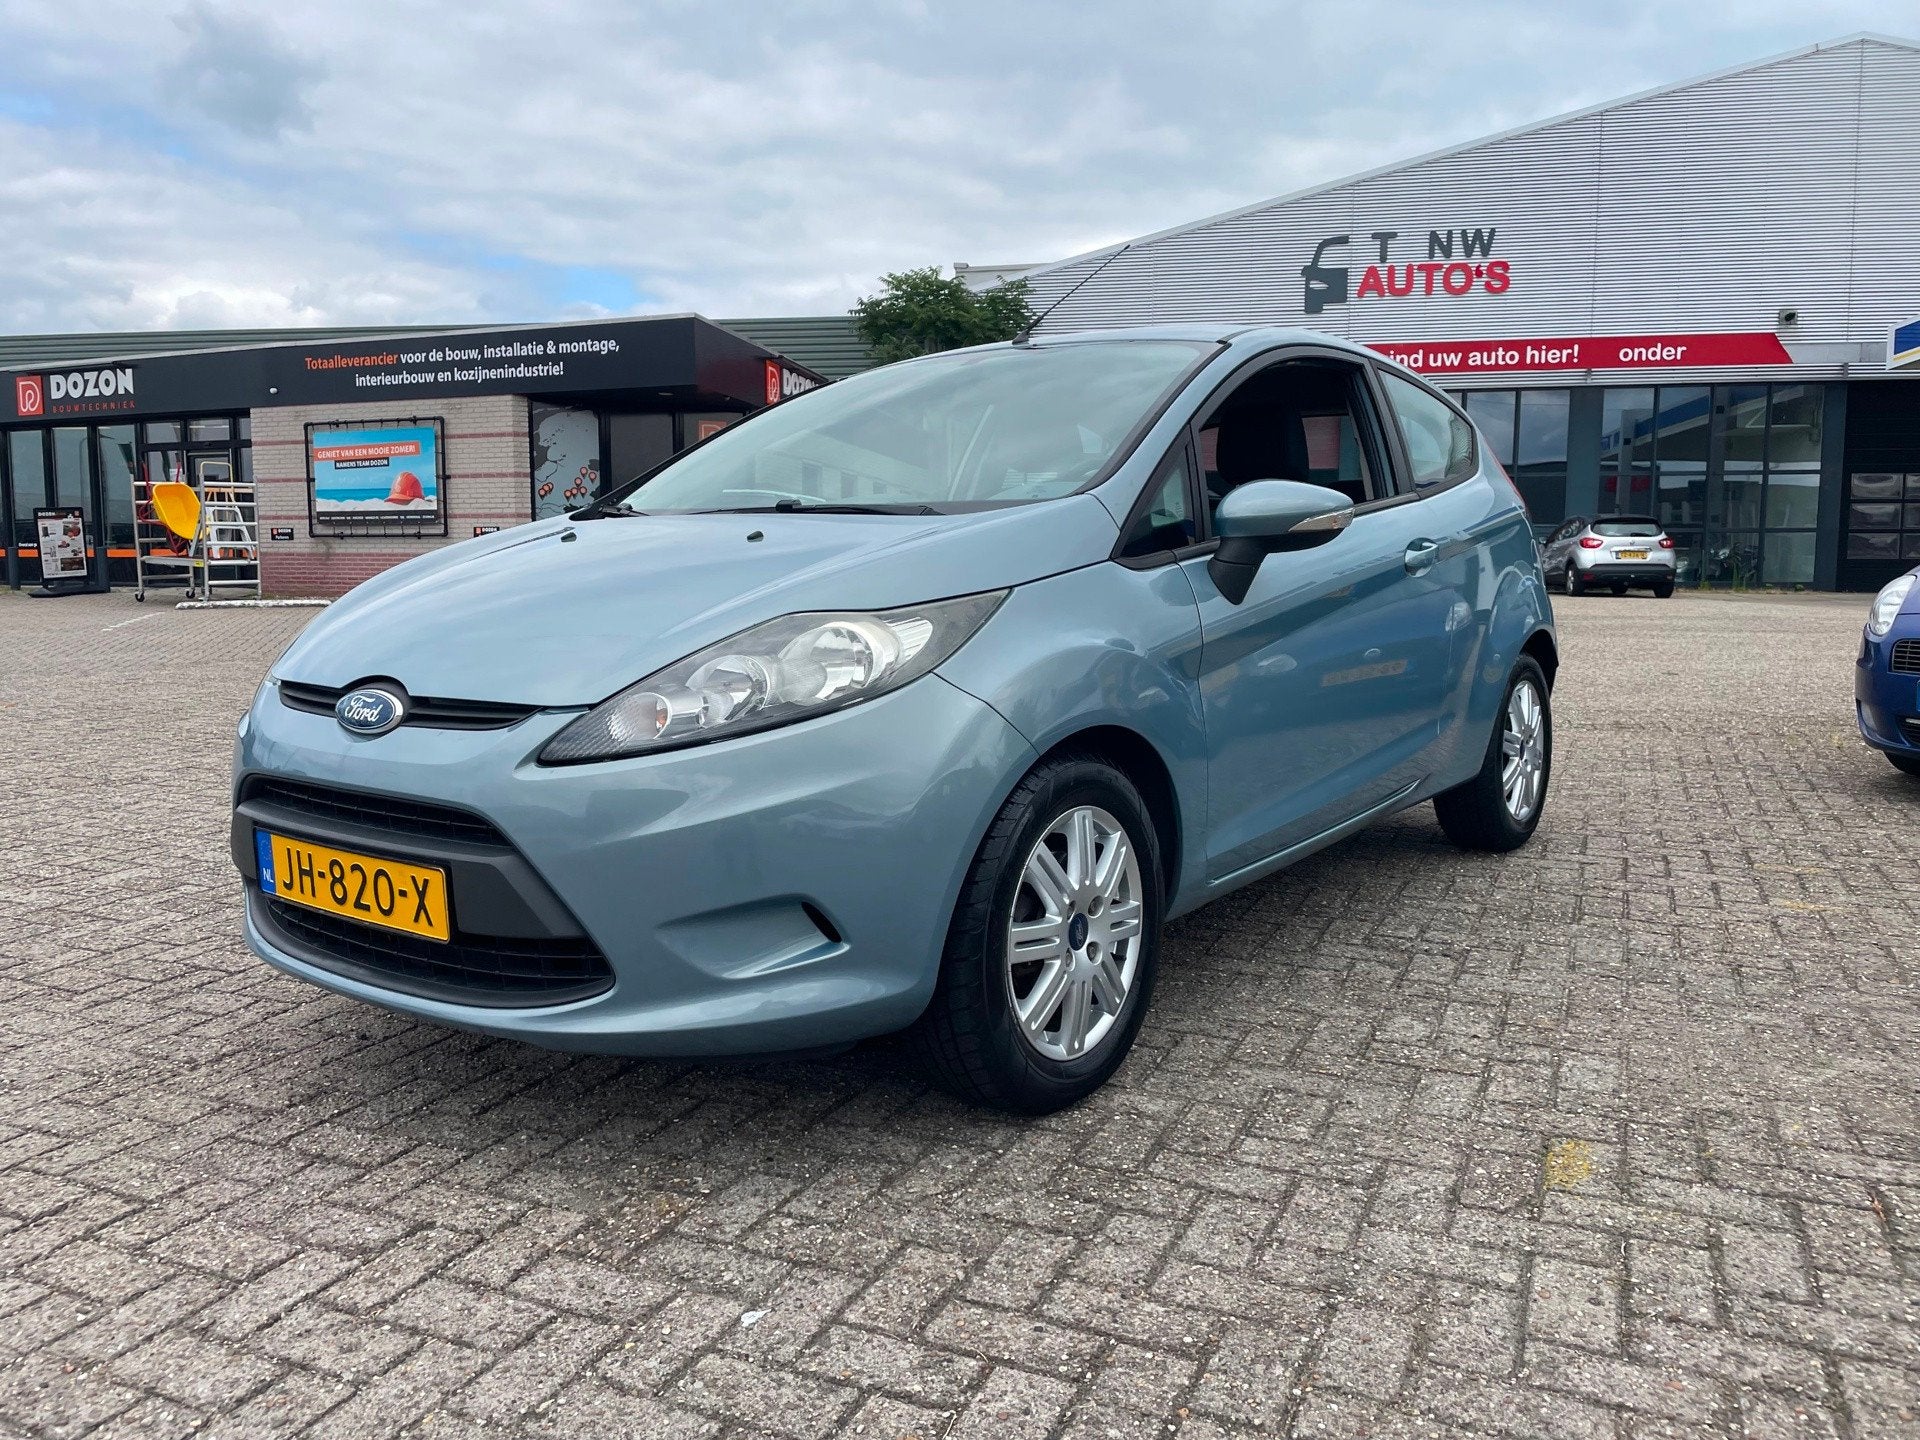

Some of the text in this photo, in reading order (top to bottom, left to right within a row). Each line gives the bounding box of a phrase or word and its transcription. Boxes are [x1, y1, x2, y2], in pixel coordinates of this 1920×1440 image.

[1371, 228, 1496, 263] T NW
[1357, 260, 1511, 298] AUTO'S
[305, 336, 620, 370] Totaalleverancier voor de bouw, installatie & montage,
[1429, 352, 1463, 367] uw
[1467, 347, 1520, 366] auto
[1525, 344, 1579, 364] hier!
[1618, 343, 1687, 362] onder
[49, 368, 134, 400] DOZON
[355, 361, 564, 387] interieurbouw en kozijnenindustrie!
[52, 400, 136, 413] BOUWTECHNIEK
[317, 451, 340, 459] GENIET
[341, 449, 354, 457] VAN
[368, 447, 390, 455] MOOIE
[345, 695, 383, 722] Ford
[262, 846, 434, 927] NL JH-820-X
